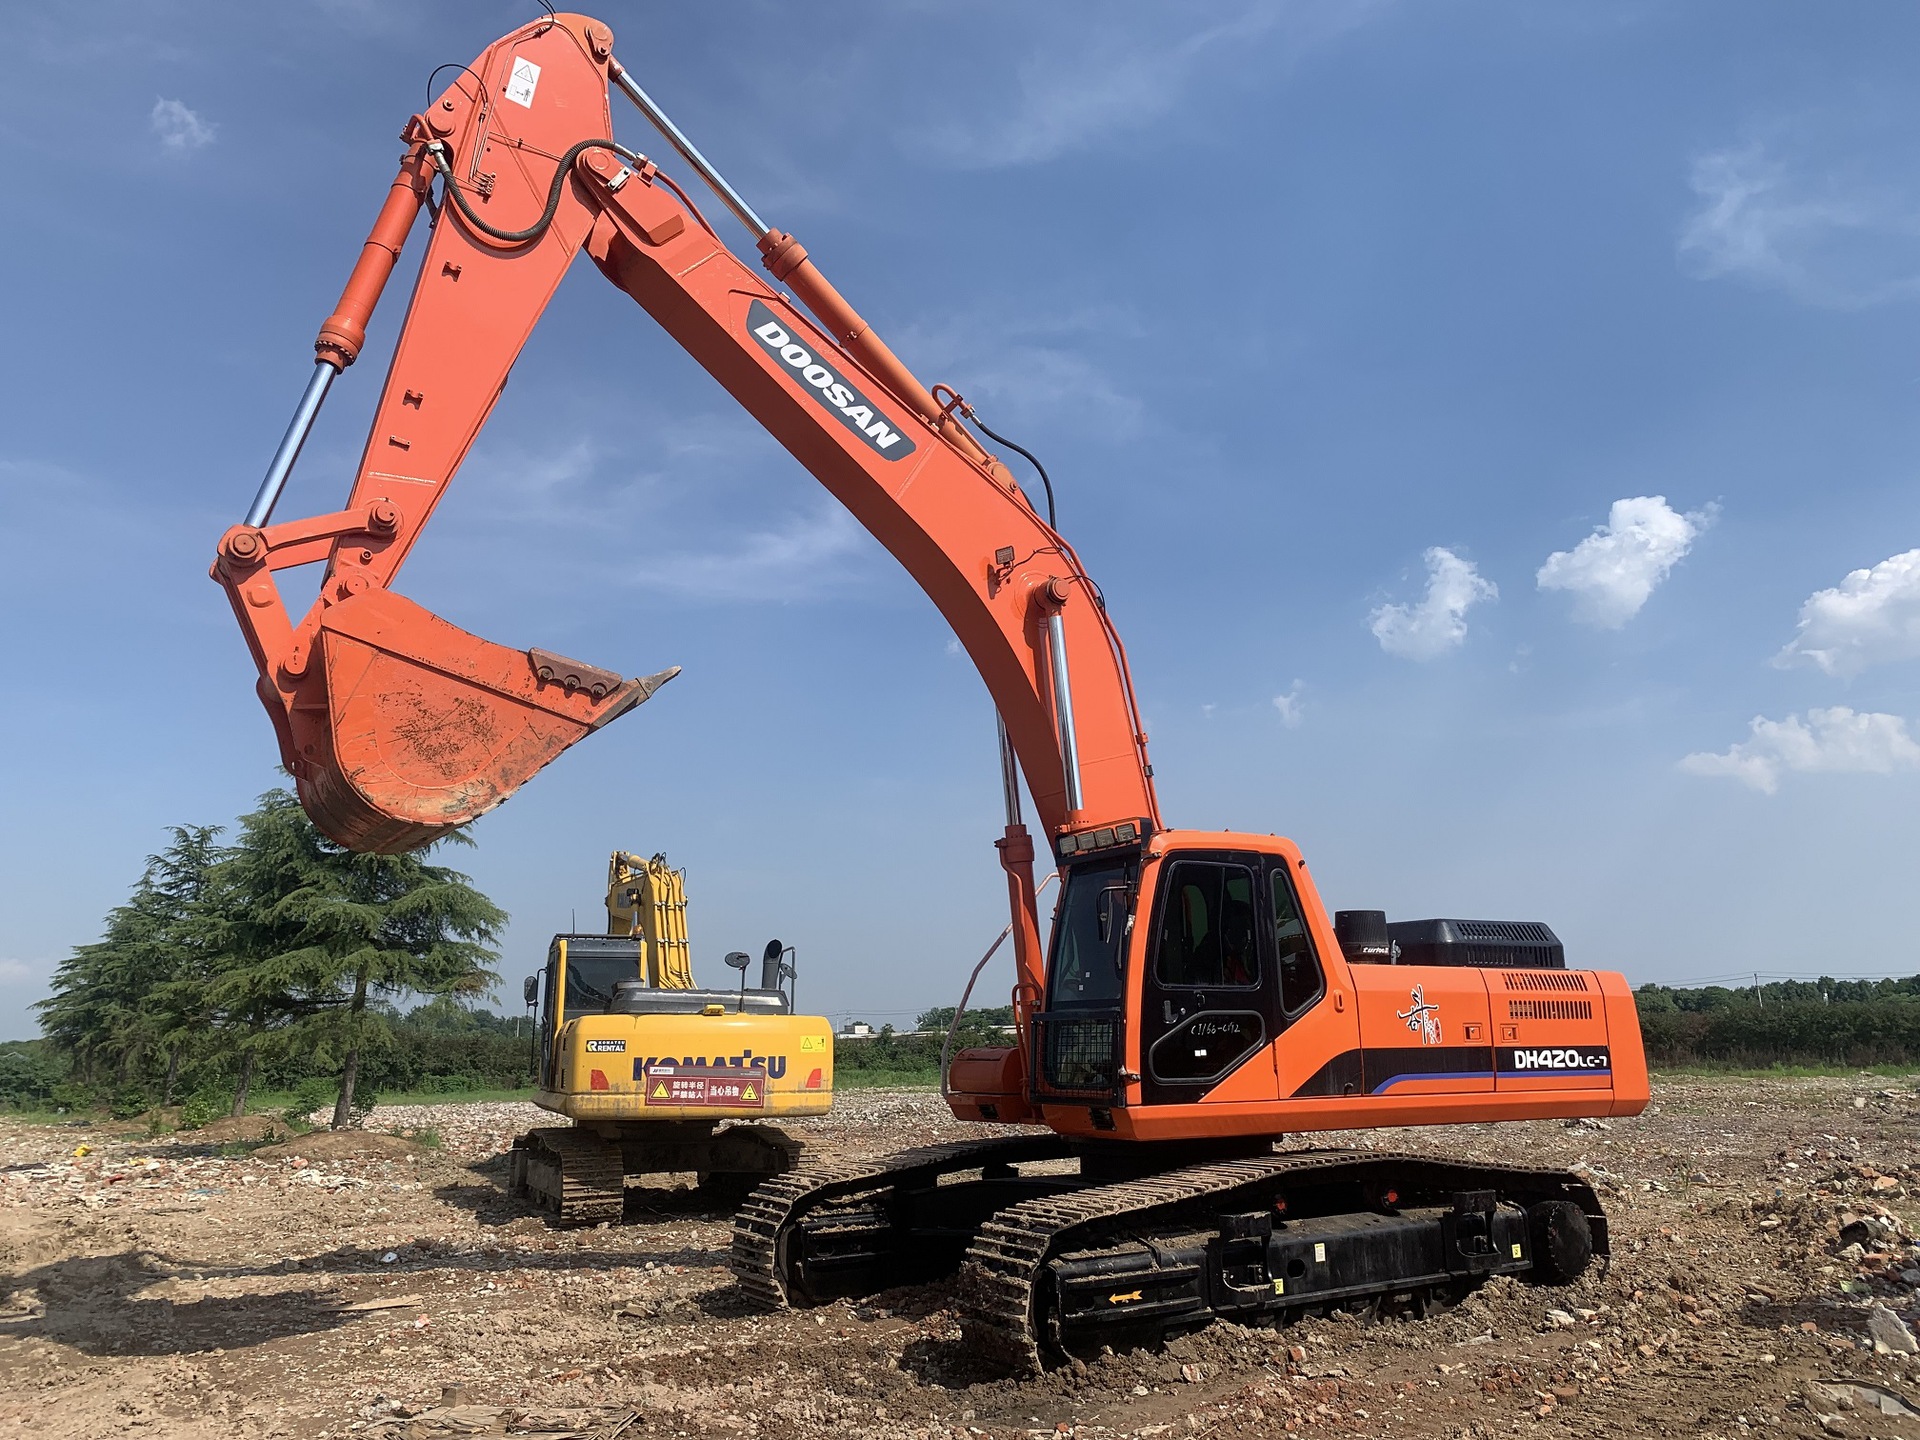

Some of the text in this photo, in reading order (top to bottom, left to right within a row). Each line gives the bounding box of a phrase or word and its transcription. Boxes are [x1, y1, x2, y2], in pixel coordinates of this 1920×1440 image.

[754, 321, 901, 449] DOOSAN
[672, 1081, 705, 1090] 旋转半径
[671, 1090, 704, 1099] 严禁站人
[710, 1085, 740, 1097] 当心吊物
